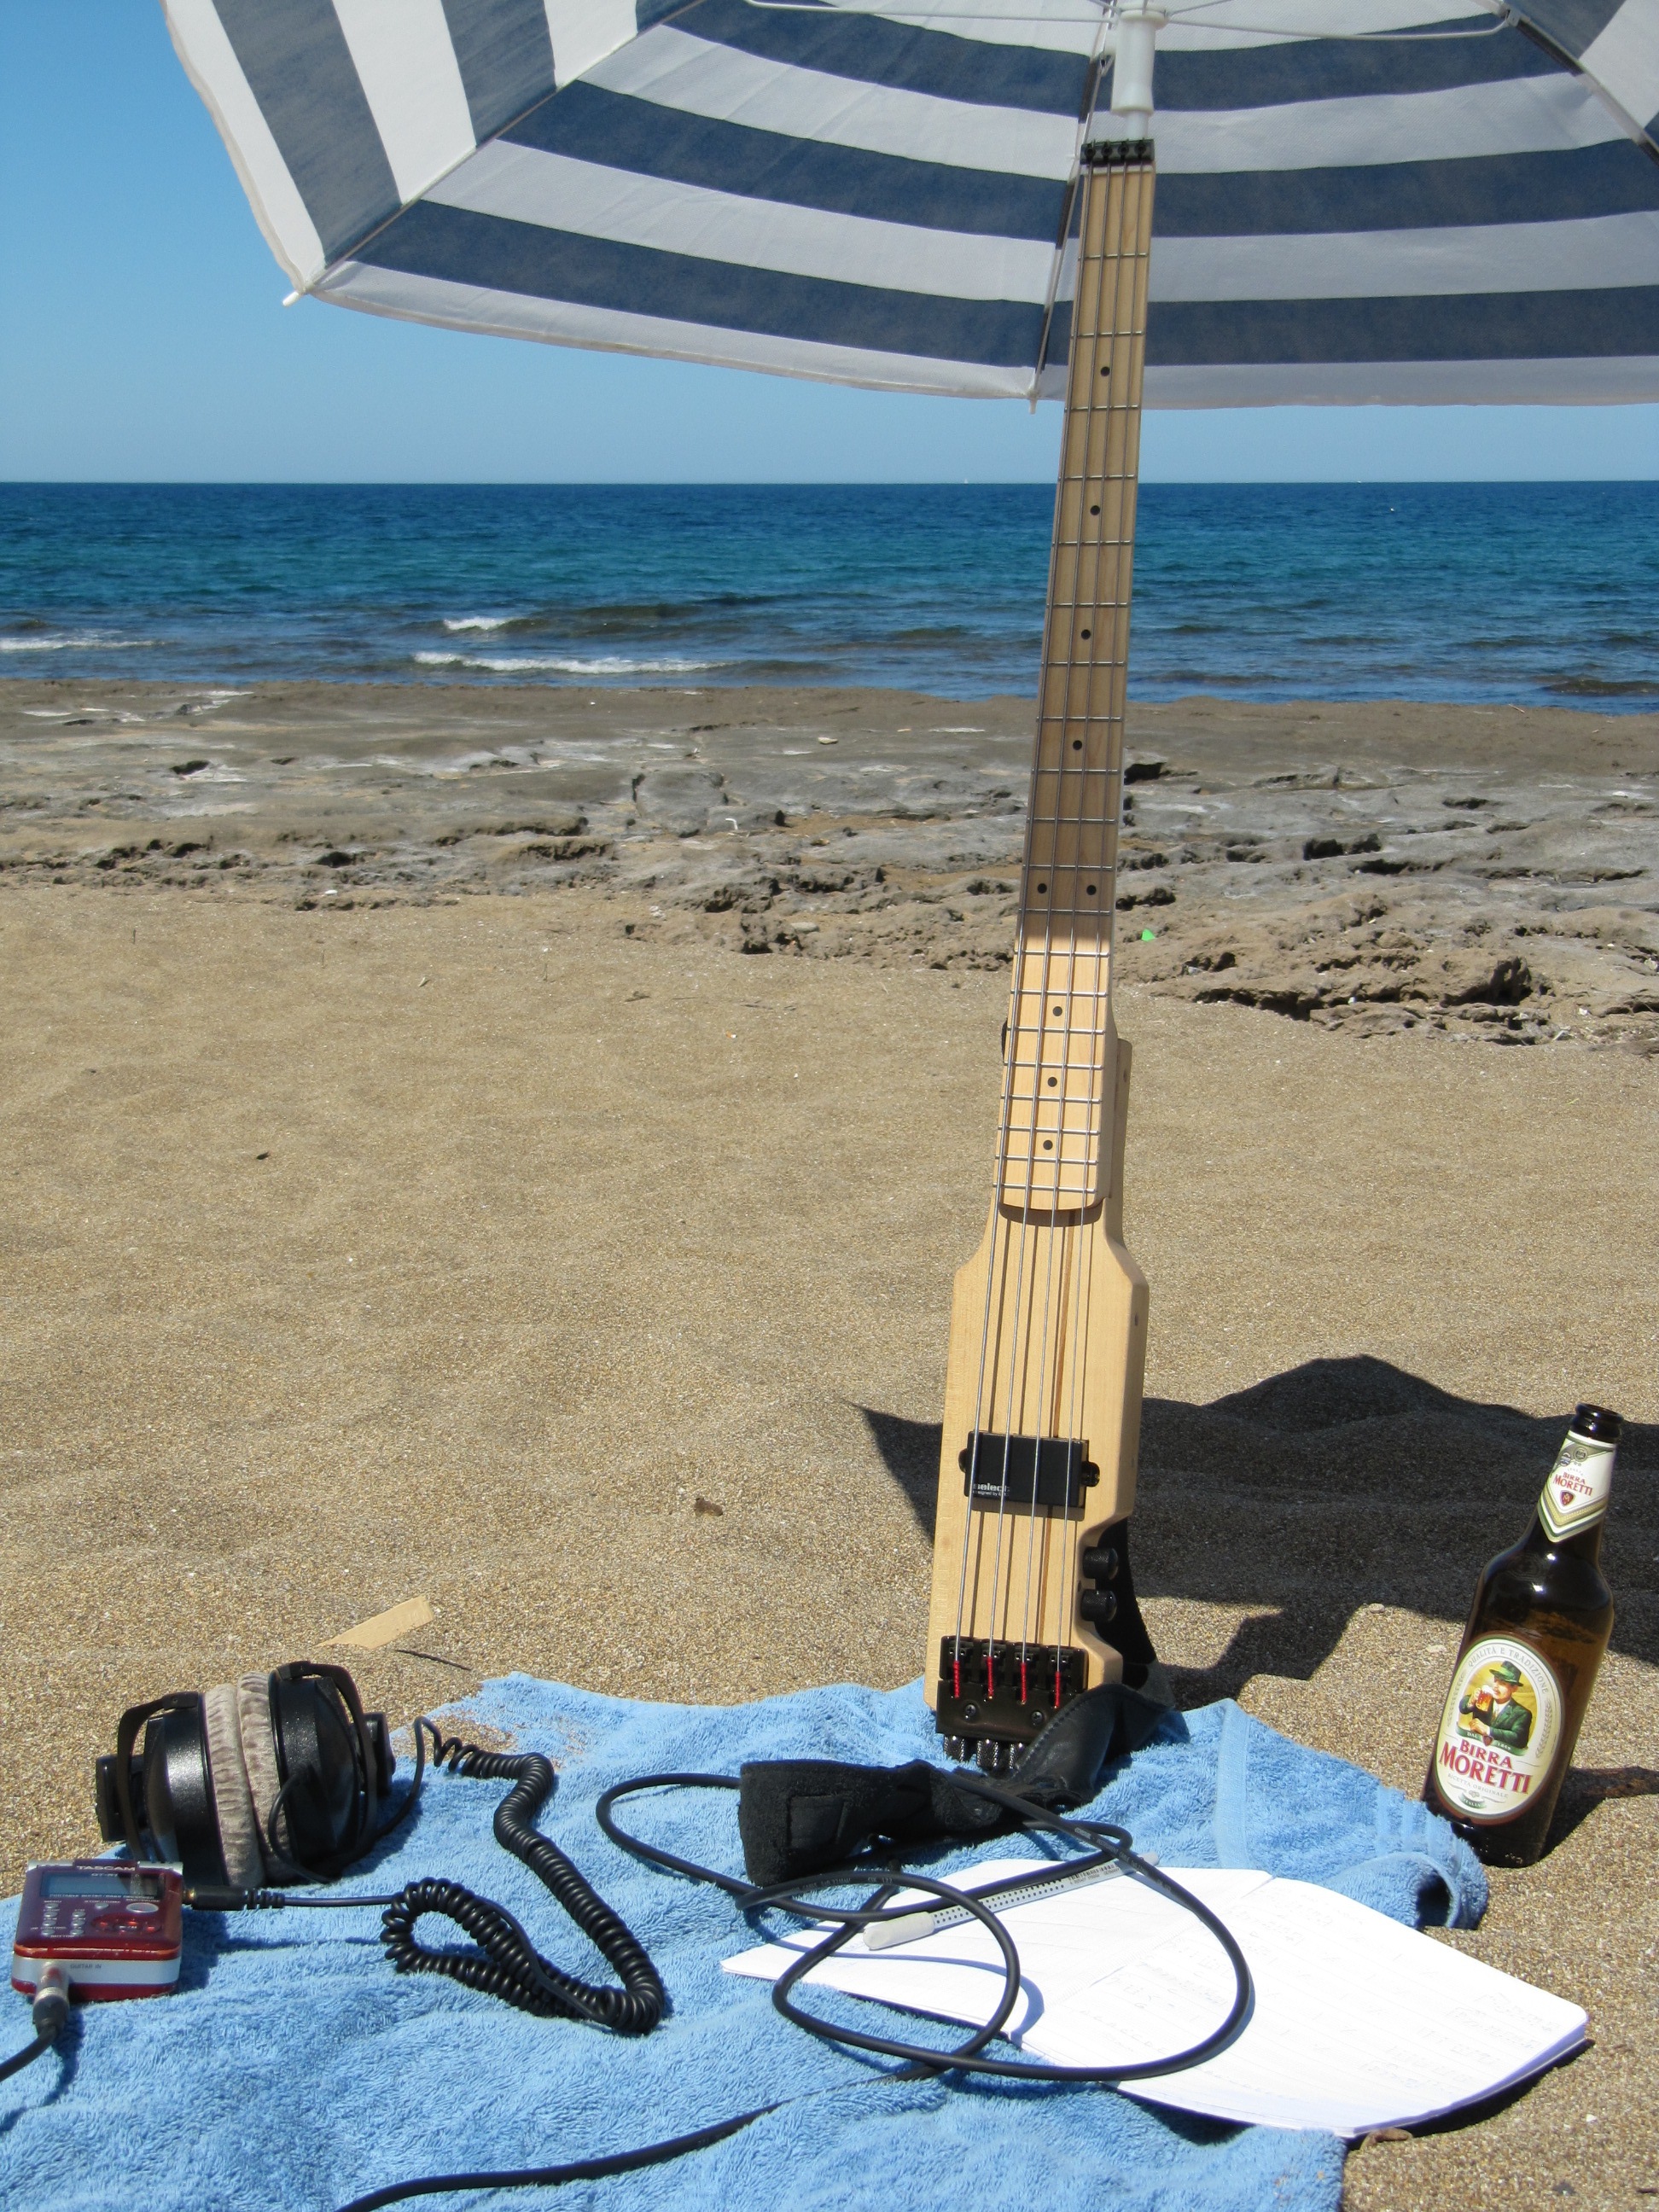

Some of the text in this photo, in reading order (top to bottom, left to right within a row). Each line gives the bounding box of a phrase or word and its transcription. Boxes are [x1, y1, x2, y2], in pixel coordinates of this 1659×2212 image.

[1552, 1474, 1593, 1496] MORETTI
[1563, 1471, 1586, 1485] BIRRA
[1509, 1649, 1548, 1694] TRADIZIONE
[1439, 1741, 1533, 1795] MORETTI
[1459, 1738, 1514, 1771] BIRRA
[1448, 1773, 1509, 1799] RICETTA ORIGINALE
